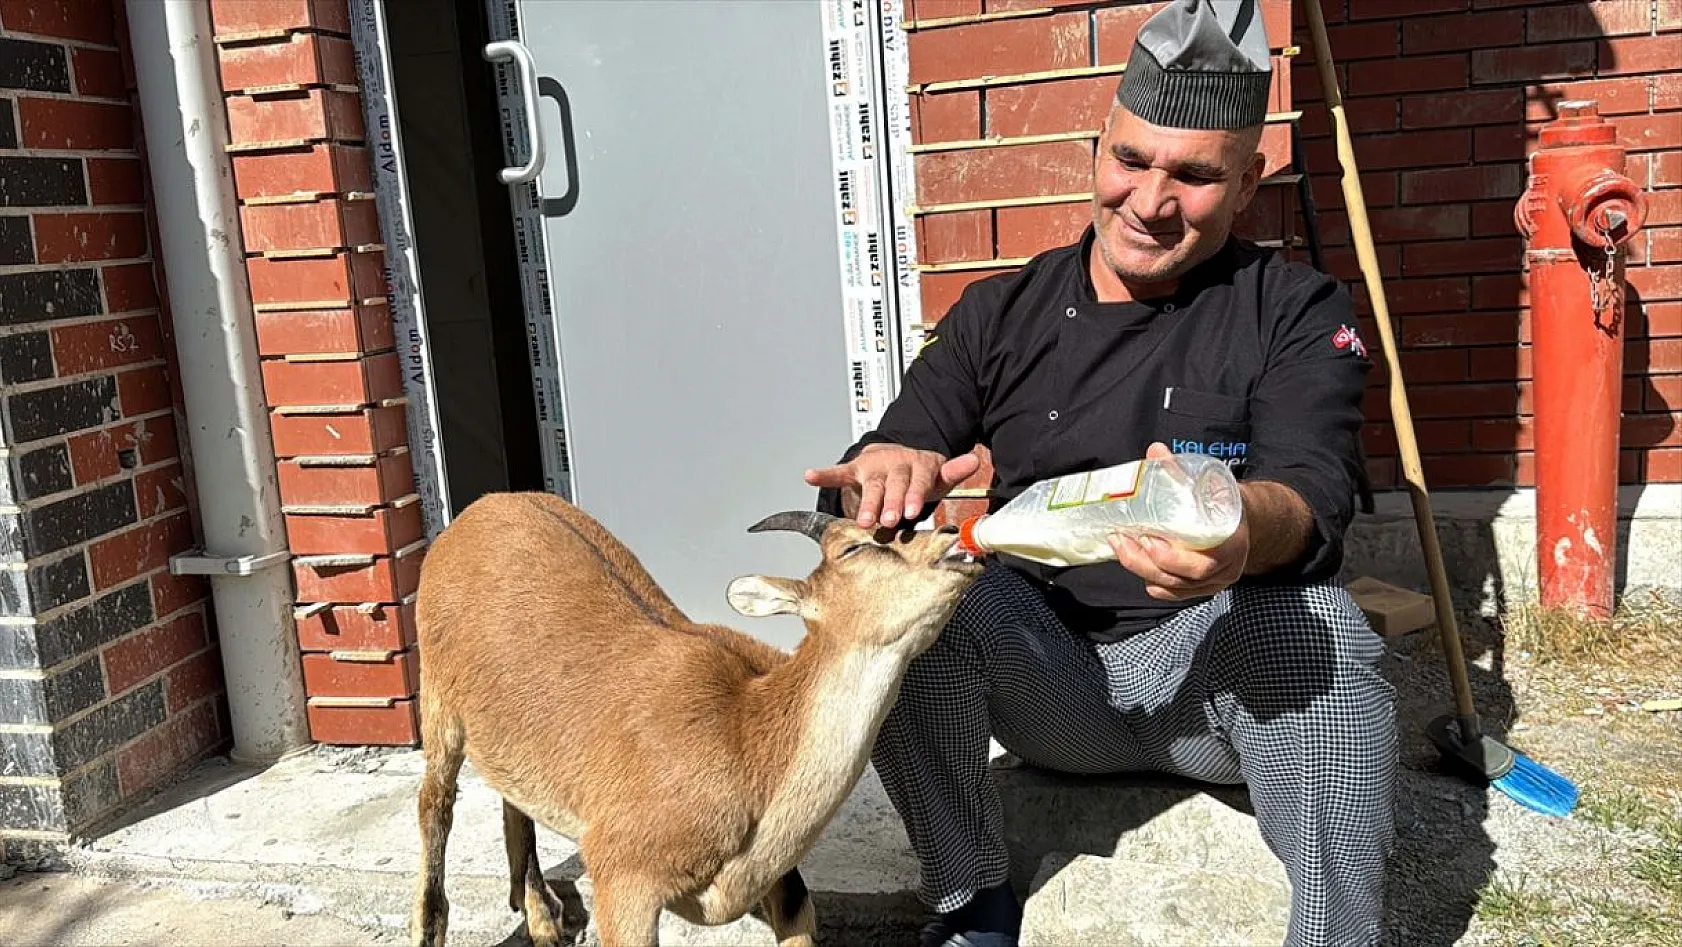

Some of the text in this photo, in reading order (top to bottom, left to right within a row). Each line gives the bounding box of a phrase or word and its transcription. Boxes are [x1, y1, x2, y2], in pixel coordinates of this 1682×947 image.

[883, 0, 895, 51] Aldo
[829, 39, 841, 80] zahit
[859, 102, 870, 143] zahit
[379, 115, 395, 173] Aldom
[839, 170, 851, 210] zahit
[867, 231, 879, 270] zahit
[897, 225, 910, 288] Aldom
[872, 300, 884, 338] zahit
[408, 329, 425, 385] Aldom
[852, 361, 864, 398] zahit
